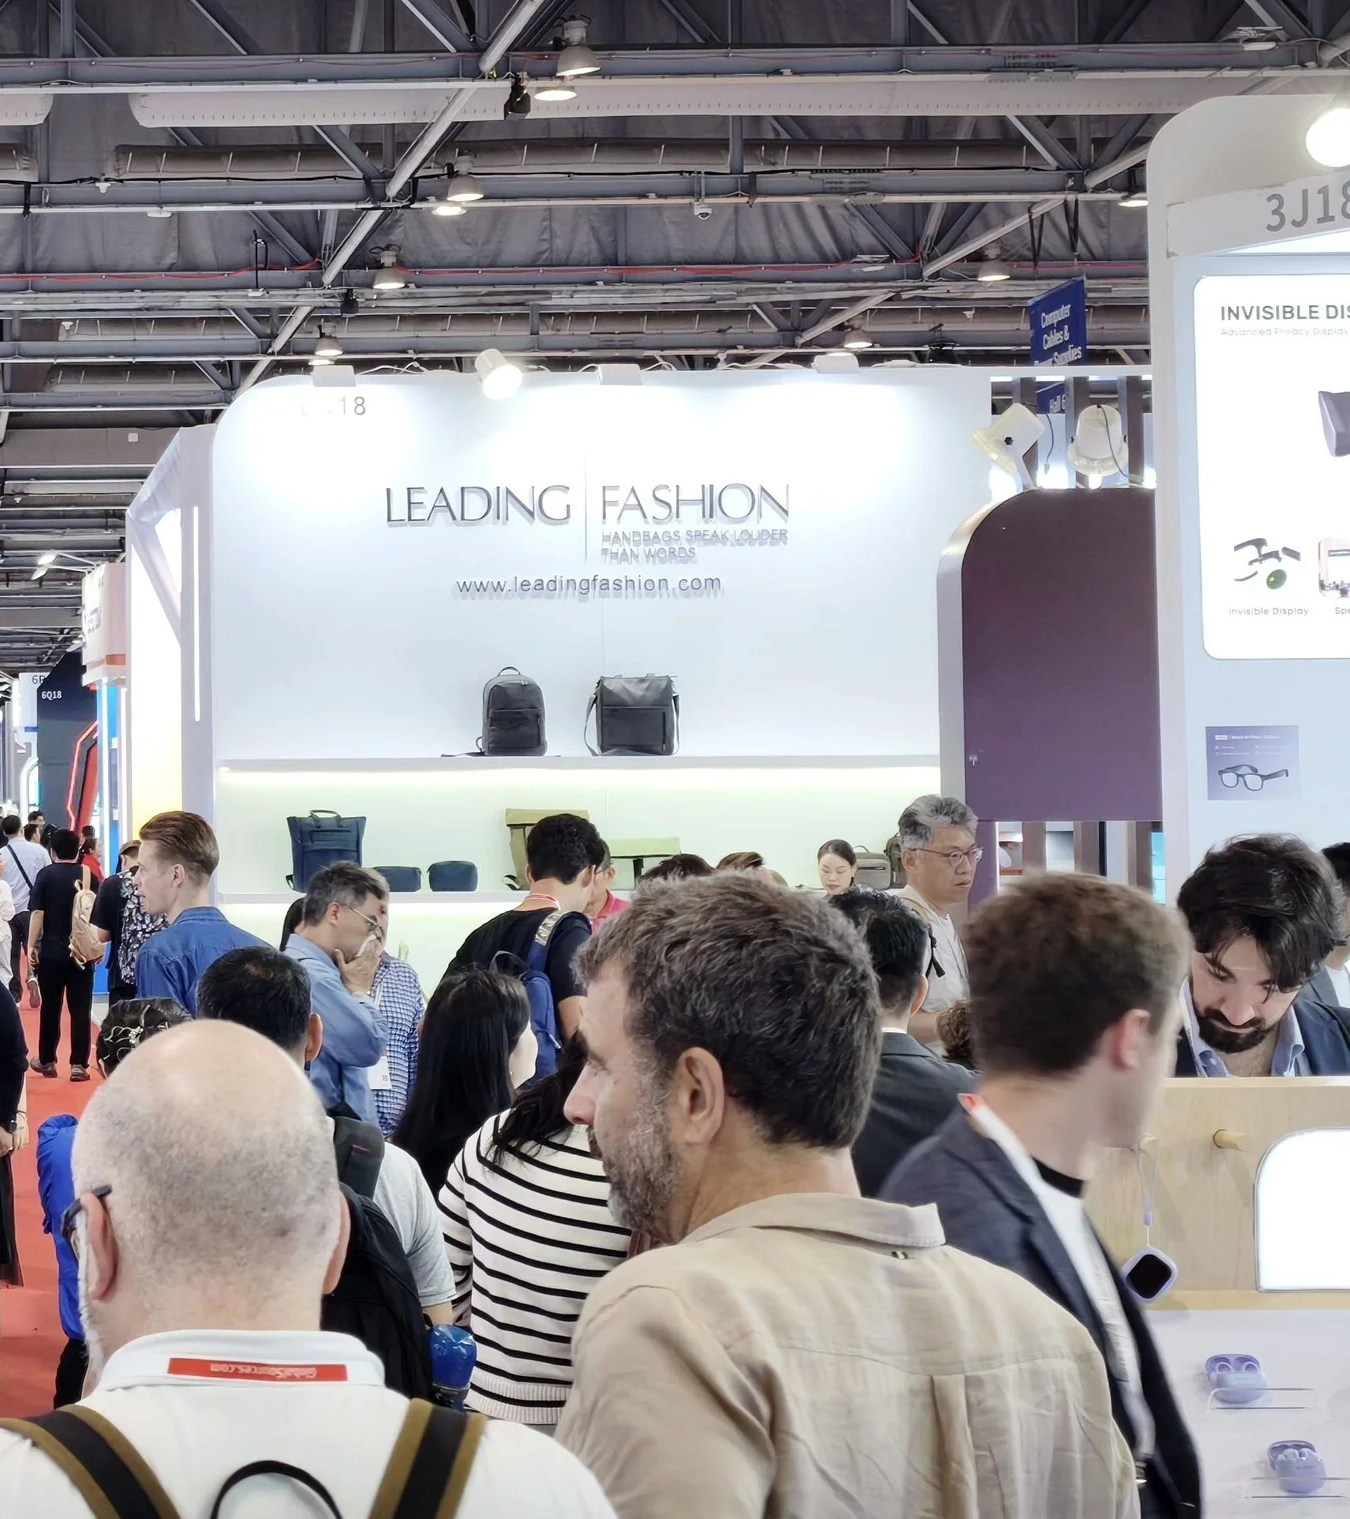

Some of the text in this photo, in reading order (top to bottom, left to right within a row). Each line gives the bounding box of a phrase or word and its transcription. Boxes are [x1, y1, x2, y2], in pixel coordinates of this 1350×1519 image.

[1041, 304, 1071, 328] Computer
[1220, 305, 1320, 320] INVISIBLE
[1042, 324, 1070, 350] Cables &
[1313, 327, 1348, 337] Display
[386, 483, 790, 525] LEADING FASHION
[602, 529, 789, 545] HANDBAGS SPEAK LOUDER
[602, 548, 697, 563] THAN WORDS
[456, 574, 722, 596] www.leadingfashion.com
[1229, 607, 1308, 616] Invisible Display
[41, 690, 62, 700] 6Q18
